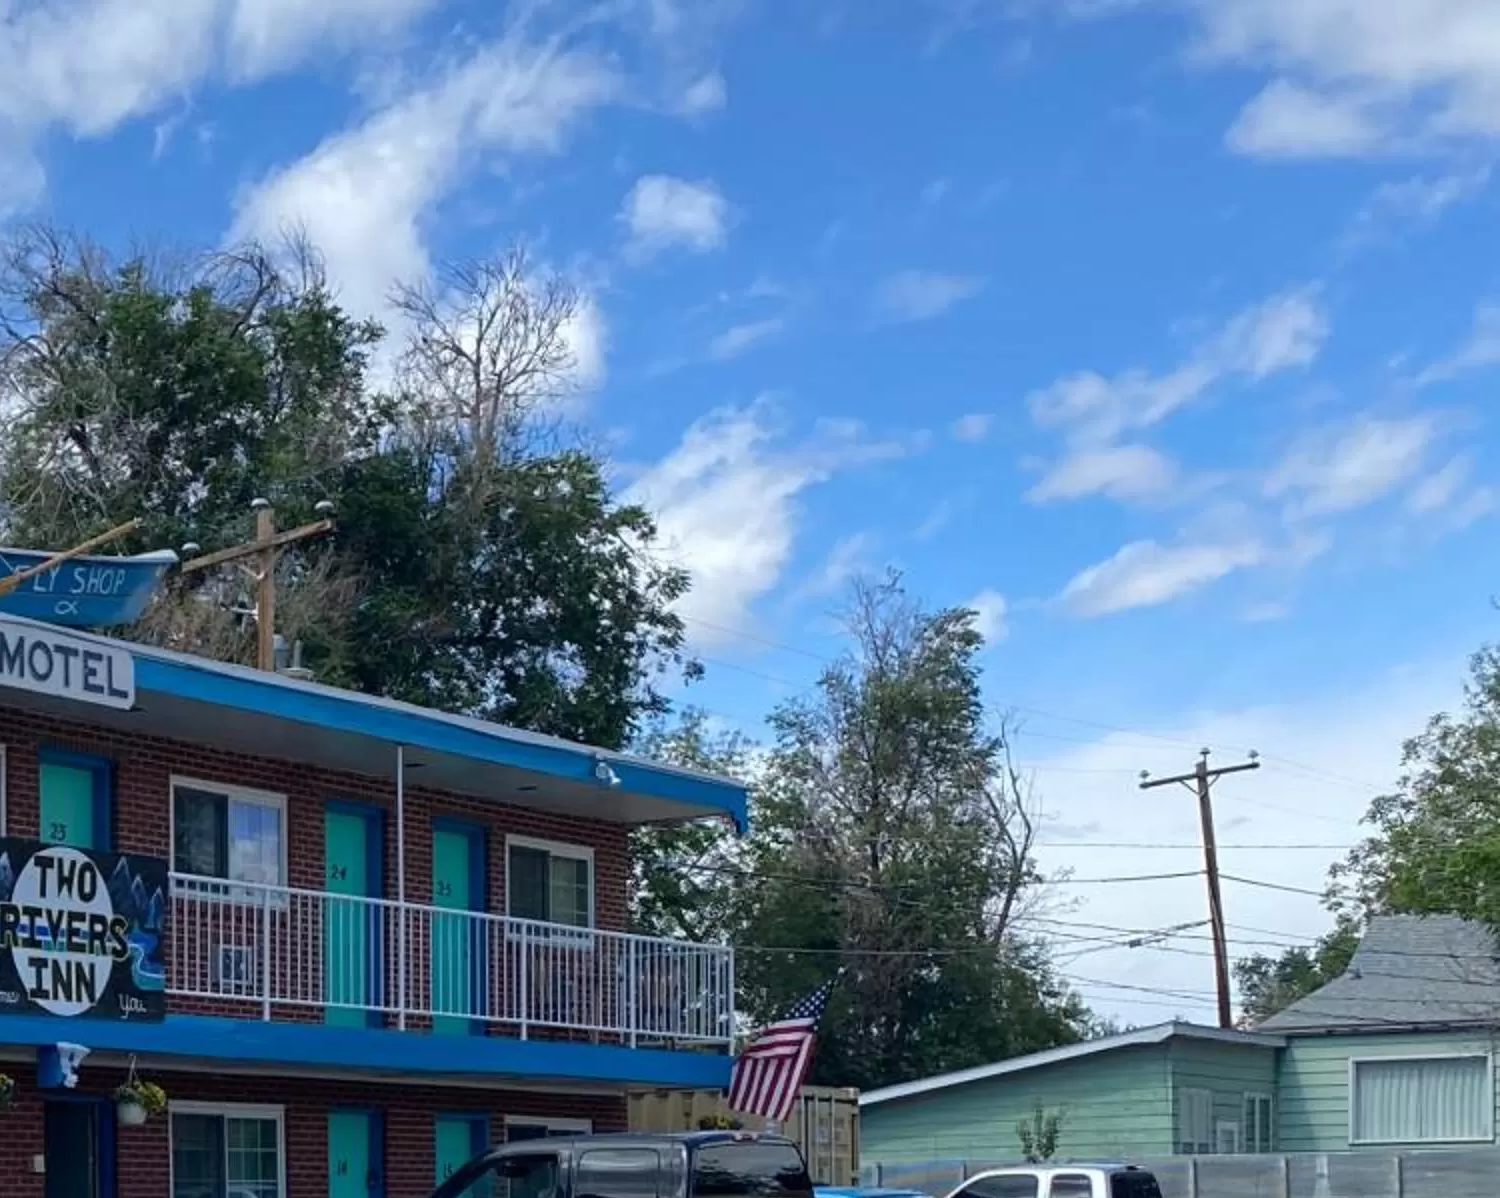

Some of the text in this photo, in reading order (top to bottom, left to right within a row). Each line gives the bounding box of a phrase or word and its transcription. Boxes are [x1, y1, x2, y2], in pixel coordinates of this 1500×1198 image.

[70, 565, 126, 594] SHOP
[33, 855, 97, 903] TWO
[28, 956, 97, 1005] INN
